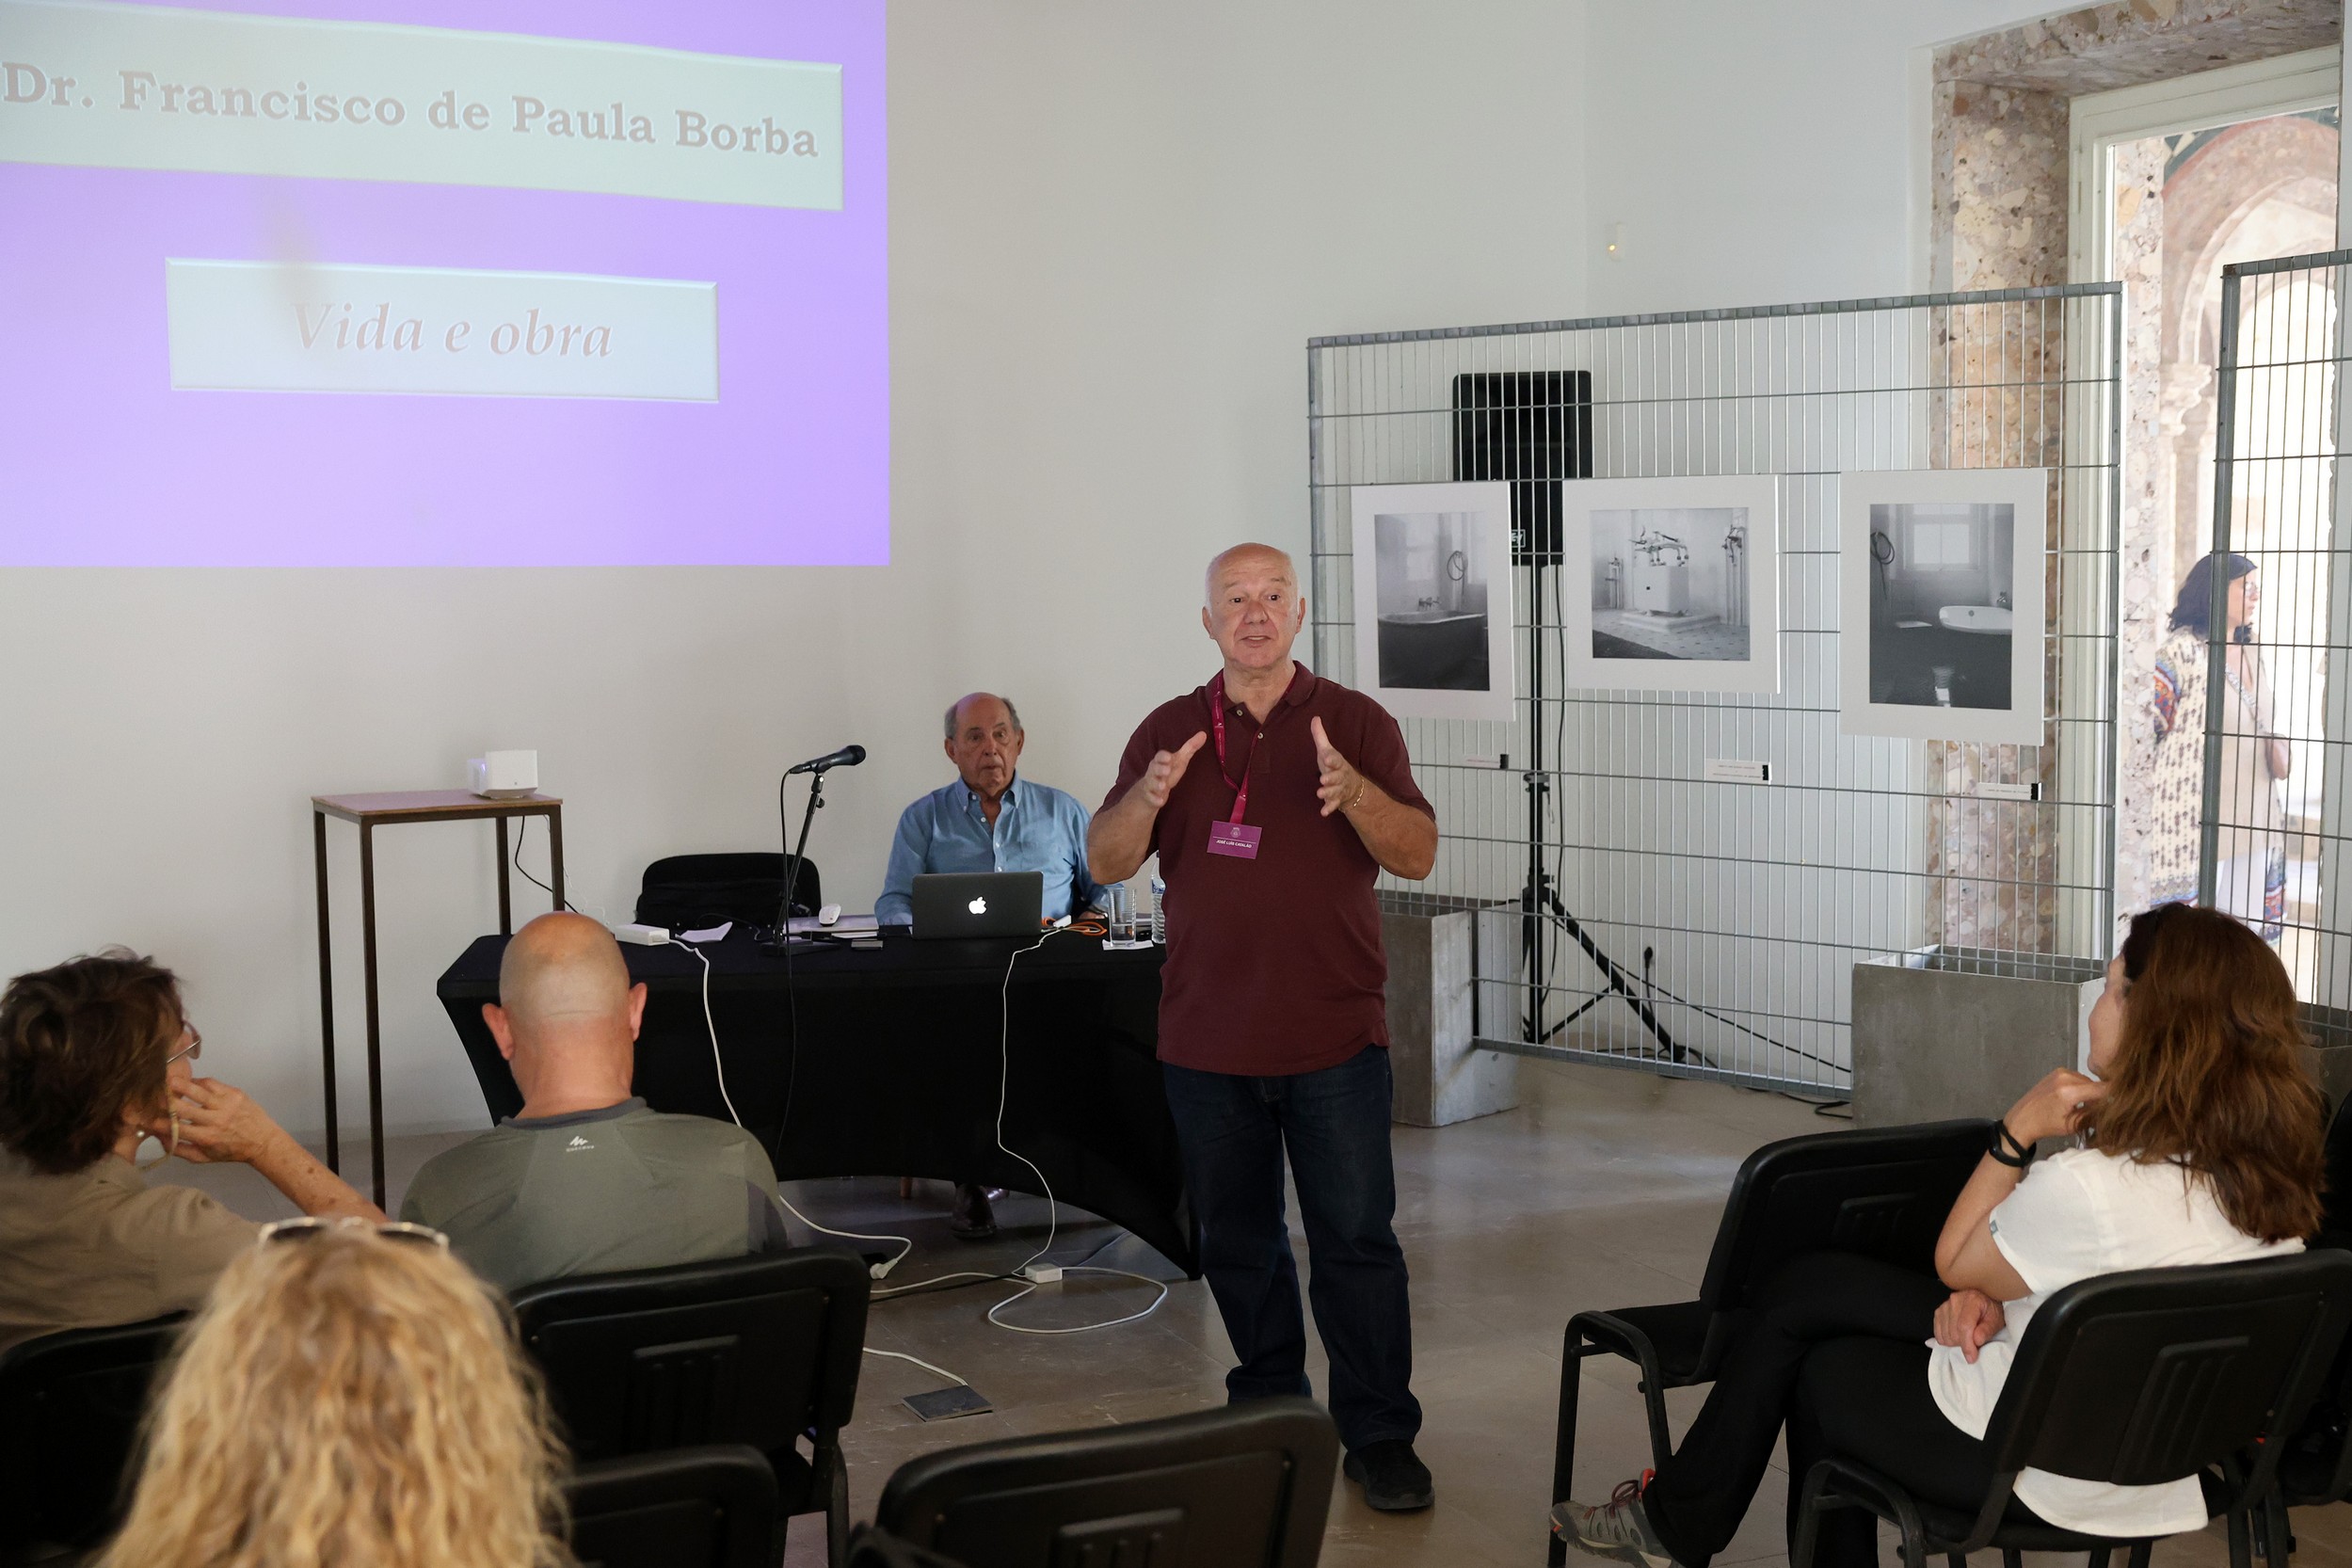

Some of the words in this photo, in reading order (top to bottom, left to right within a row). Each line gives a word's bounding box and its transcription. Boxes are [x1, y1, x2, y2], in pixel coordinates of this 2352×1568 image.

[2, 60, 95, 109] Dr.
[118, 69, 407, 126] Francisco
[427, 89, 490, 131] de
[511, 95, 656, 144] Paula
[675, 109, 820, 157] Borba
[290, 301, 424, 353] Vida
[444, 320, 472, 353] e
[489, 308, 614, 358] obra
